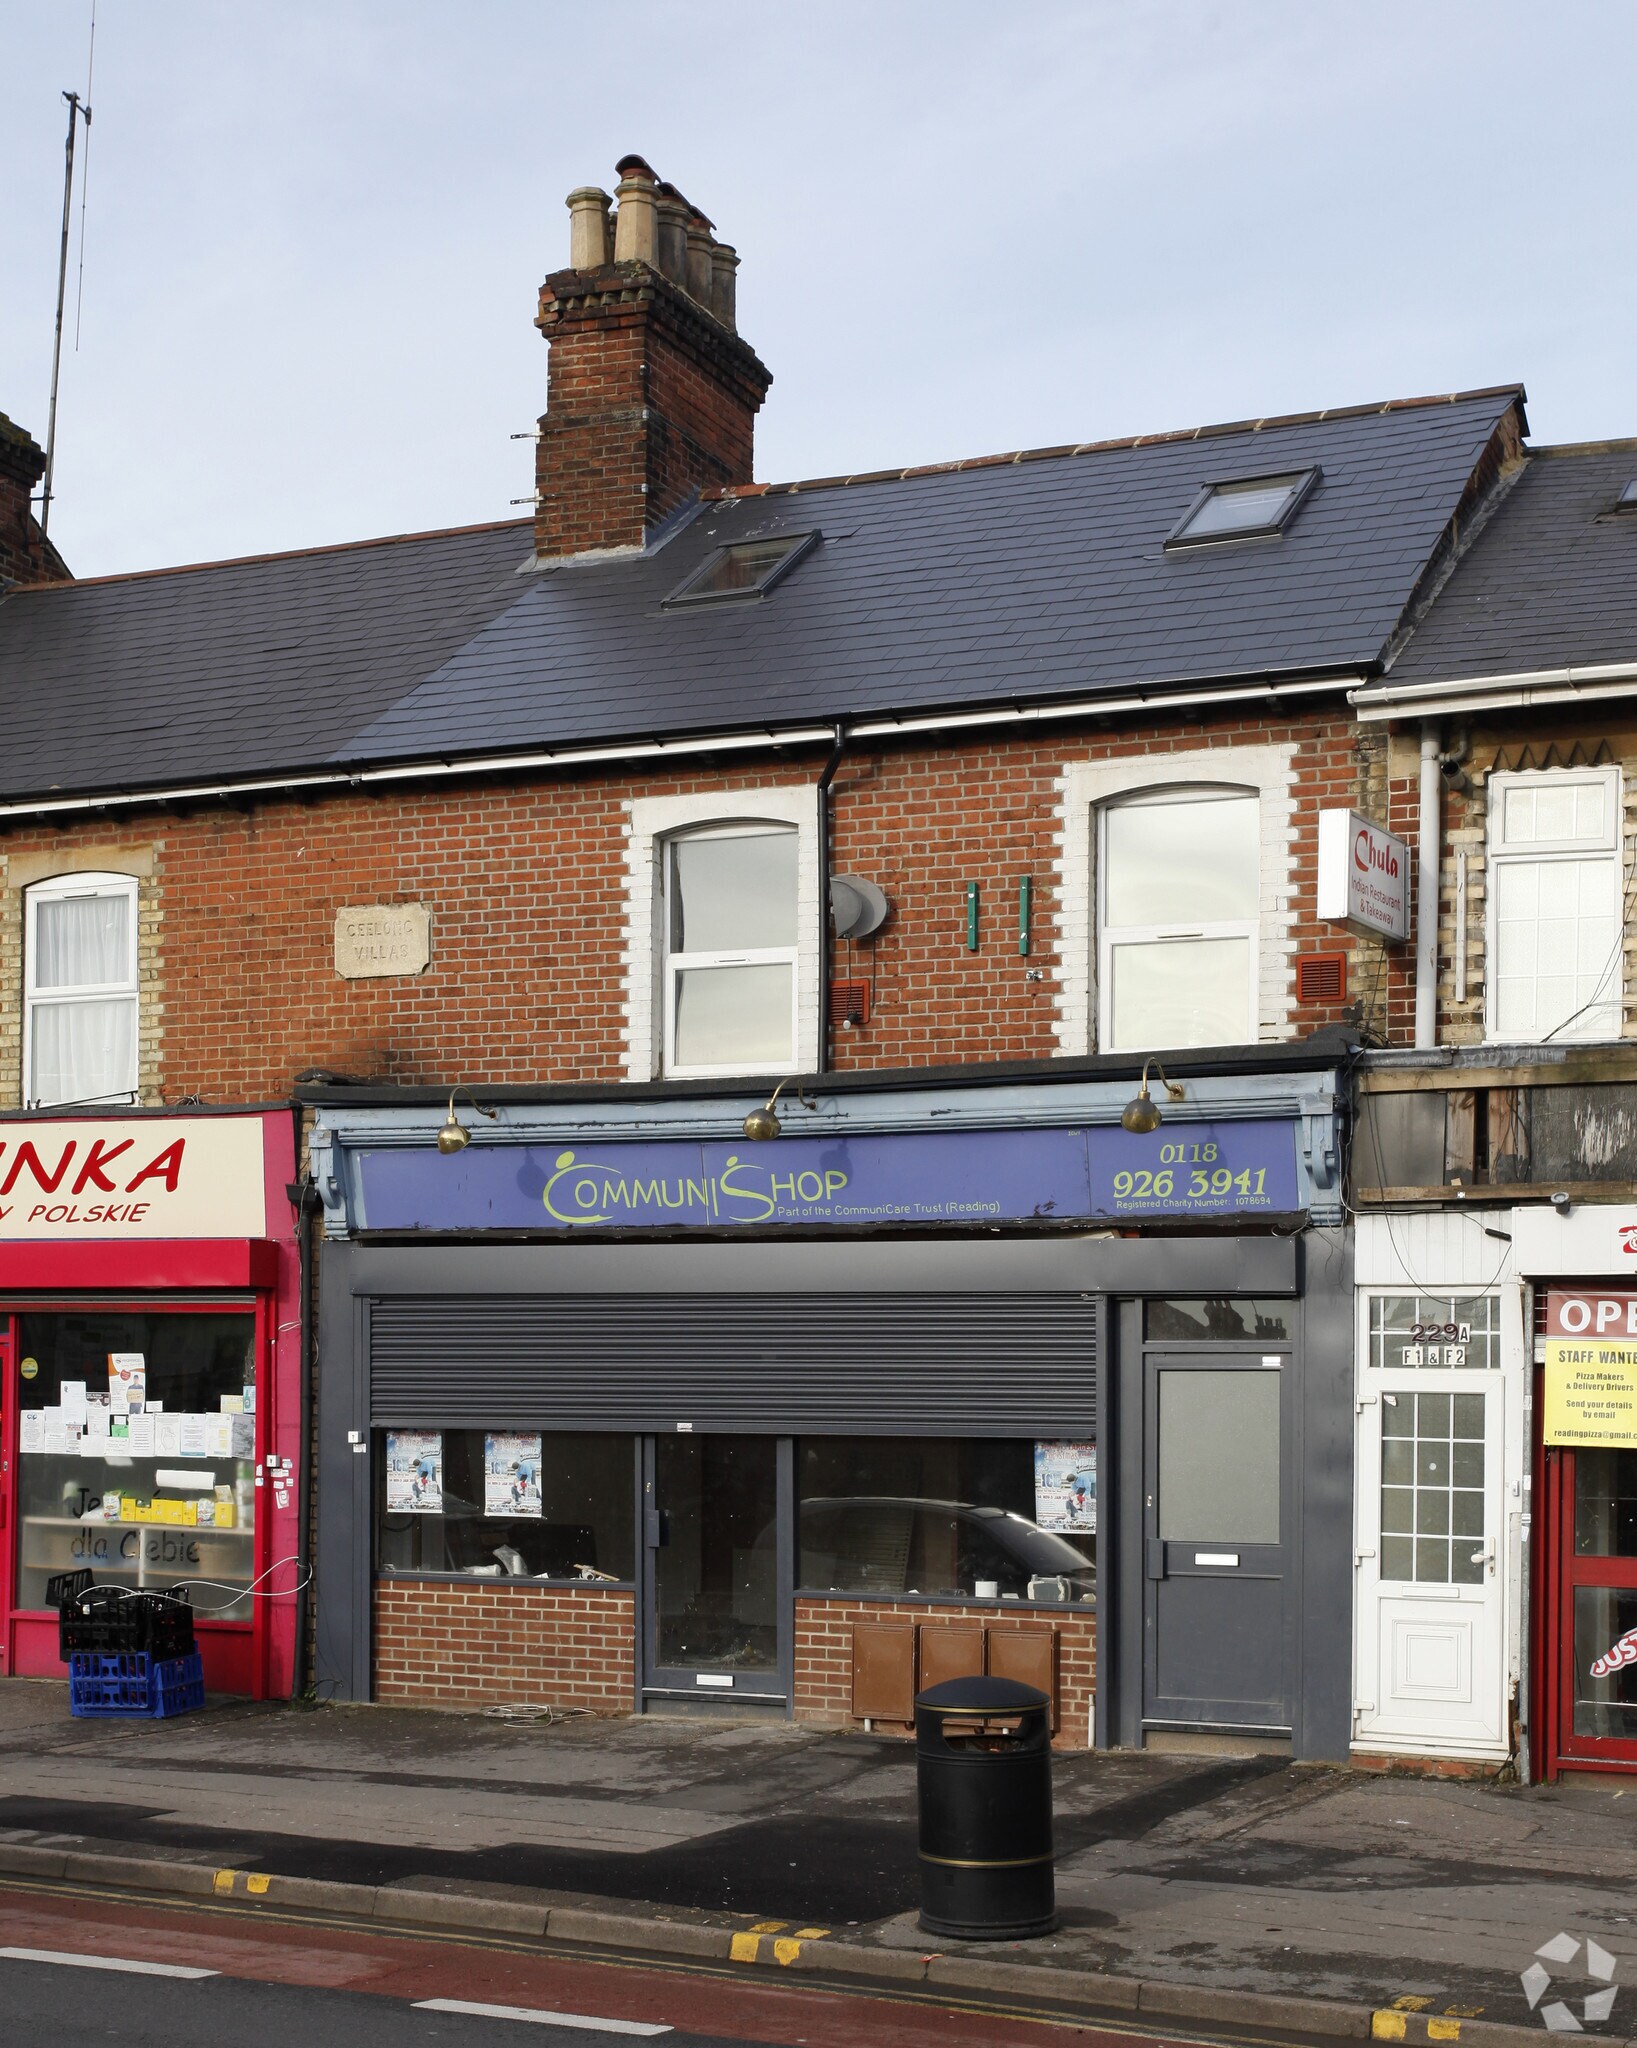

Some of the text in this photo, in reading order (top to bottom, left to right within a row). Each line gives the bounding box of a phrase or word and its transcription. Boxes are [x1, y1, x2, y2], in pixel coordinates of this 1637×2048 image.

[1354, 829, 1398, 878] Chula
[1351, 875, 1401, 911] Indian Restaurant
[1360, 898, 1394, 929] & Takeaway
[354, 944, 409, 960] VILLAS
[1159, 1143, 1218, 1164] 0118
[1113, 1167, 1267, 1198] 926 3941
[777, 1201, 1001, 1216] Part of the CommuniCare Trust (Reading)
[1116, 1200, 1161, 1210] Registered
[1163, 1199, 1191, 1208] Charity
[1194, 1198, 1231, 1207] Number:
[27, 1203, 151, 1223] POLSKIE
[1429, 1352, 1438, 1364] &
[1558, 1349, 1594, 1363] STAFF
[1576, 1372, 1625, 1381] Pizza Makers
[1573, 1382, 1605, 1391] Delivery
[1606, 1383, 1634, 1391] Drivers
[1566, 1399, 1633, 1411] Send your details
[1582, 1410, 1616, 1419] by email
[71, 1527, 200, 1562] dla Cebie
